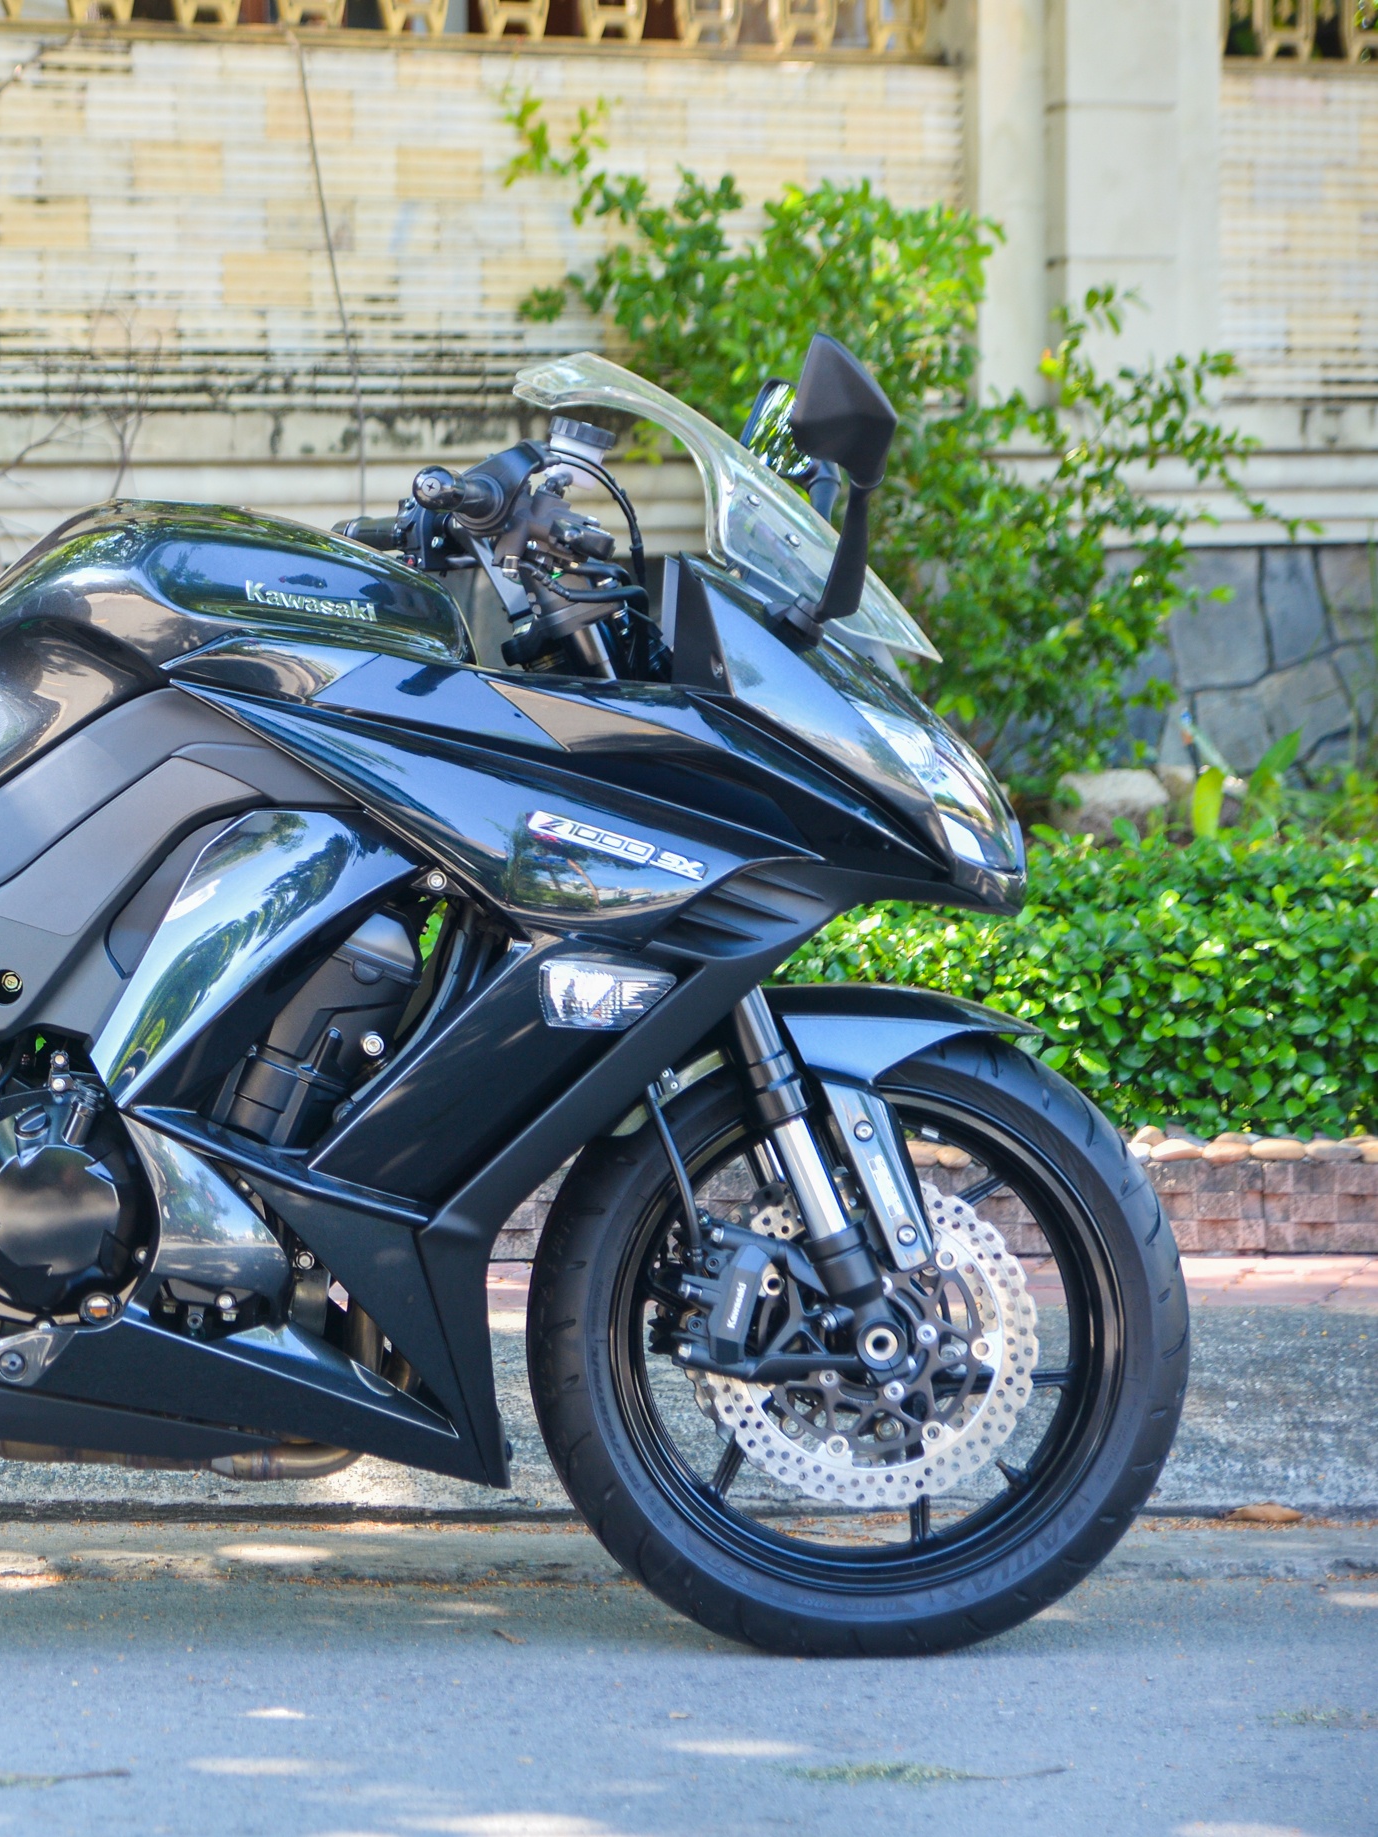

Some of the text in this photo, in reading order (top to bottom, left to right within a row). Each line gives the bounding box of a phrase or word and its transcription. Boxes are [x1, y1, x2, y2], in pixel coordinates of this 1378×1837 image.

[245, 579, 378, 622] Kawasaki
[538, 815, 704, 876] Z1000 SX
[726, 1281, 747, 1330] Kawasaki
[938, 1500, 1087, 1604] BATTLAX
